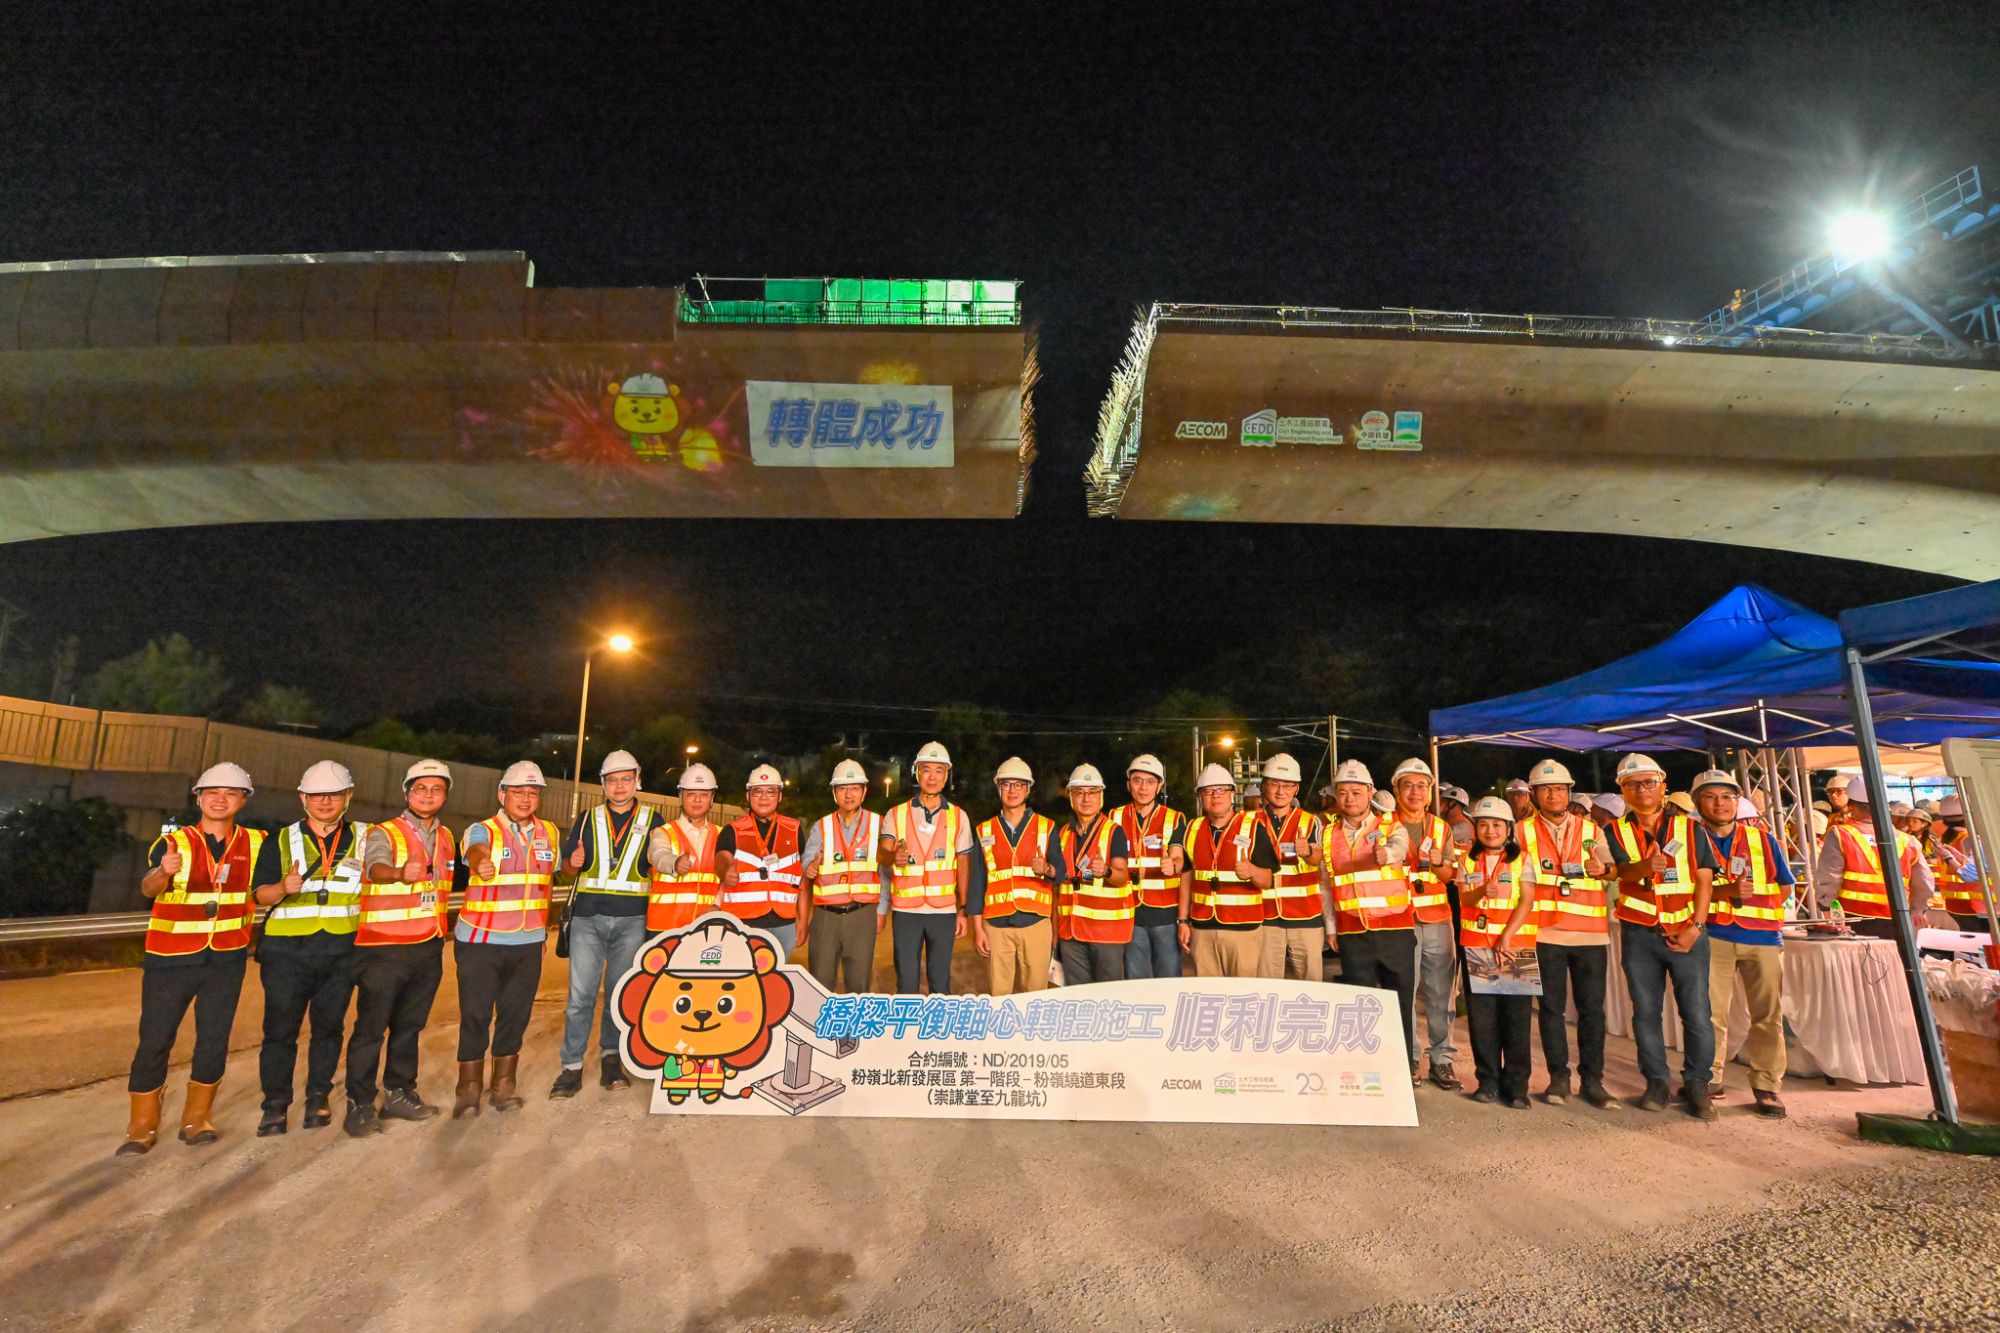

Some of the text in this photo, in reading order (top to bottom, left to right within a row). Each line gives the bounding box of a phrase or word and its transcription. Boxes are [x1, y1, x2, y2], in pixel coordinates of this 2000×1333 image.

[768, 396, 945, 449] 轉體成功
[1243, 422, 1274, 435] CEDD
[1177, 422, 1226, 437] AECOM
[700, 951, 722, 960] CEDD
[815, 992, 1382, 1054] 橋樑平衡軸心轉體施工 順利完成
[1161, 1078, 1202, 1091] AECOM
[1213, 1079, 1237, 1088] CEDD
